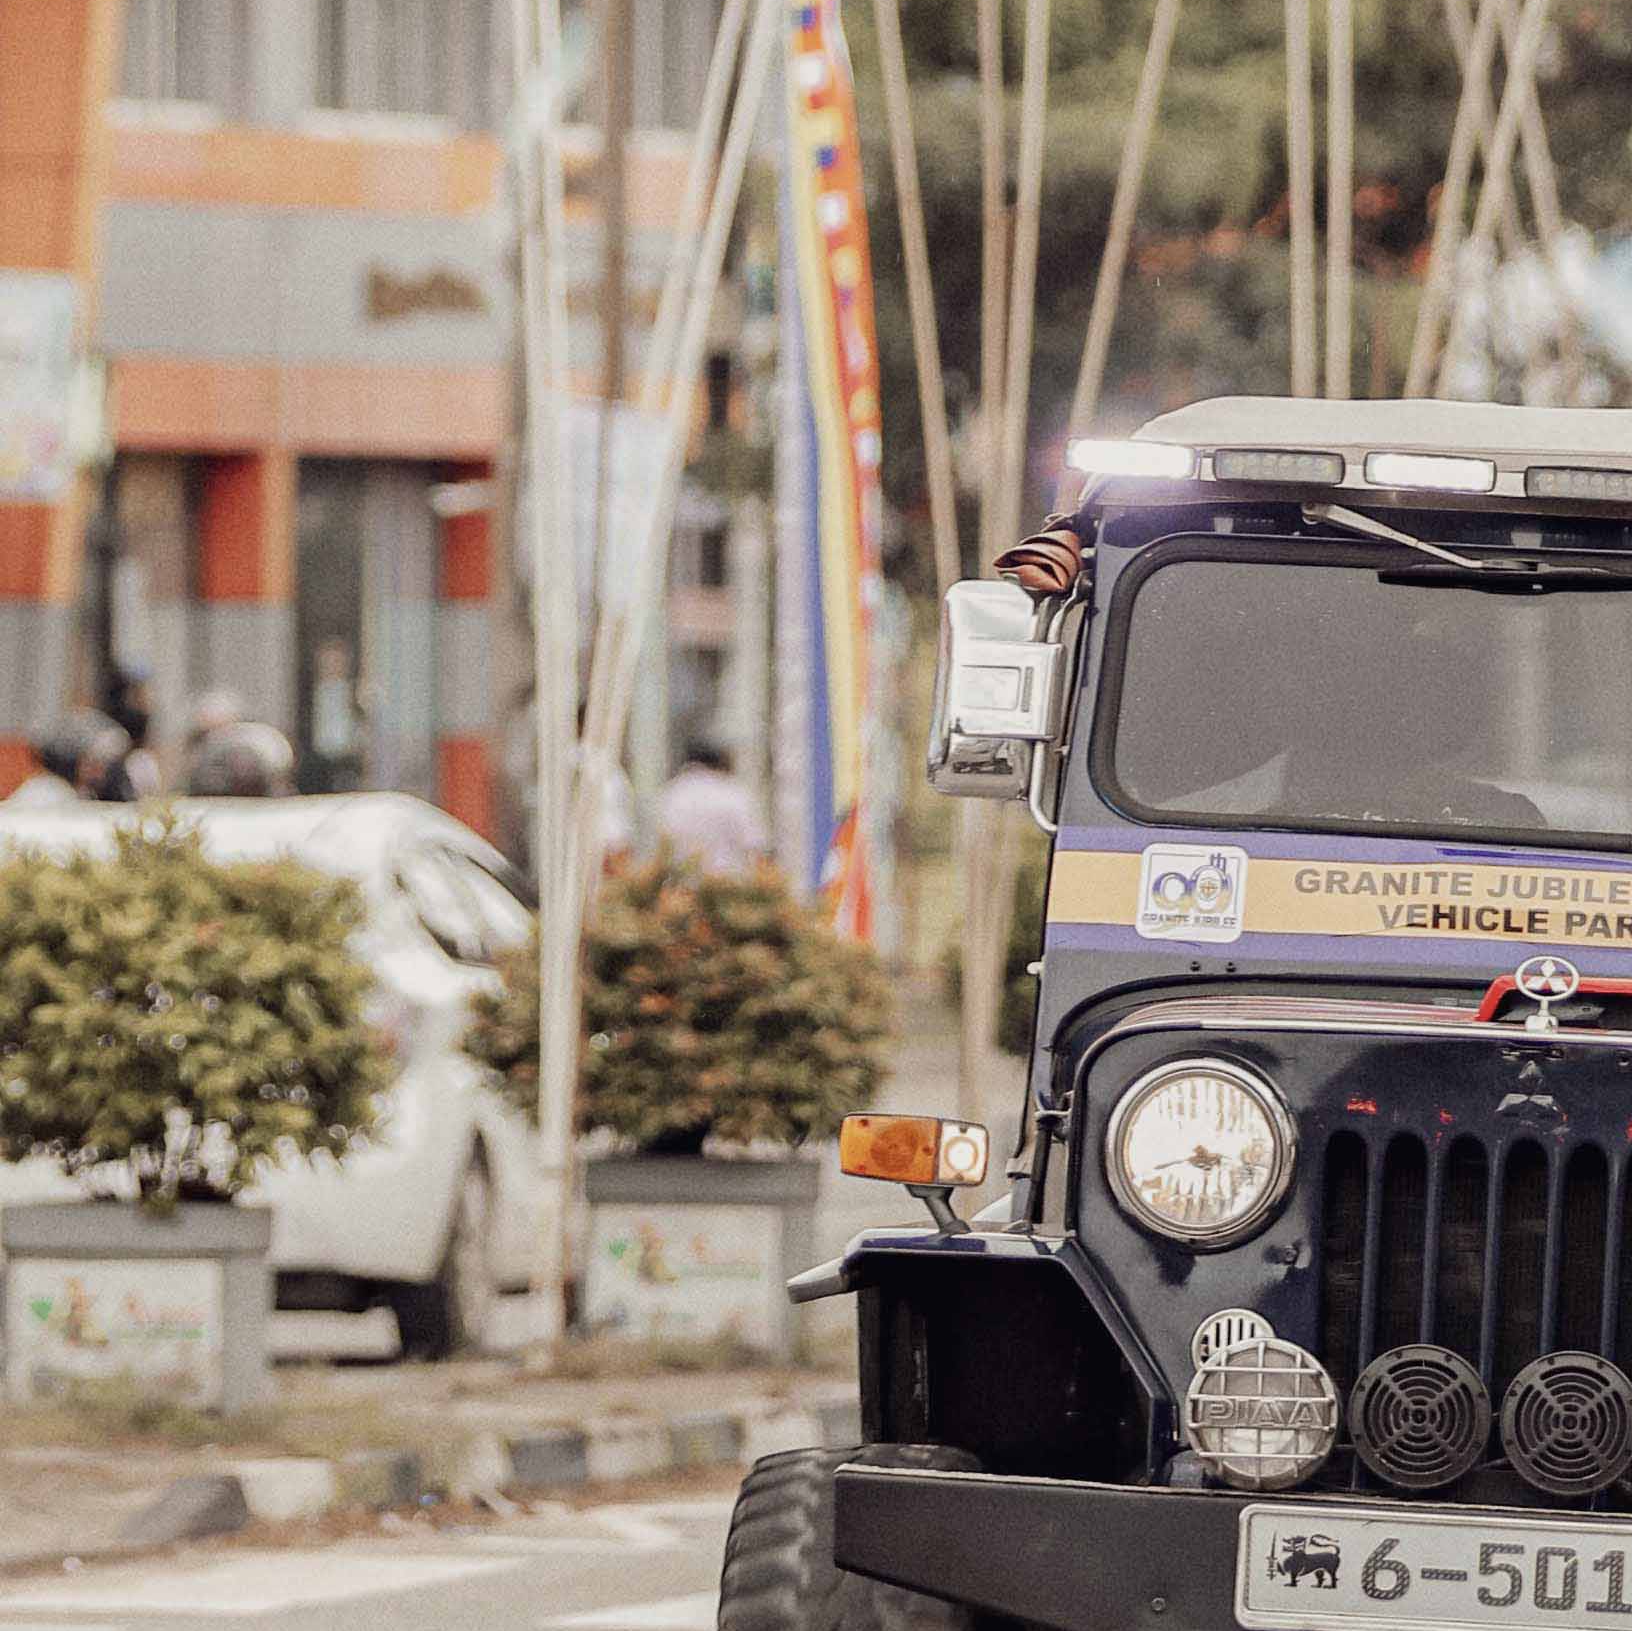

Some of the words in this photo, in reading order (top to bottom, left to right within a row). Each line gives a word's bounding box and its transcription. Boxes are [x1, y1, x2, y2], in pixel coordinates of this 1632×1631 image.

[1294, 867, 1474, 897] GRANITE
[1378, 904, 1550, 935] VEHICLE
[1200, 1398, 1323, 1429] PIAA
